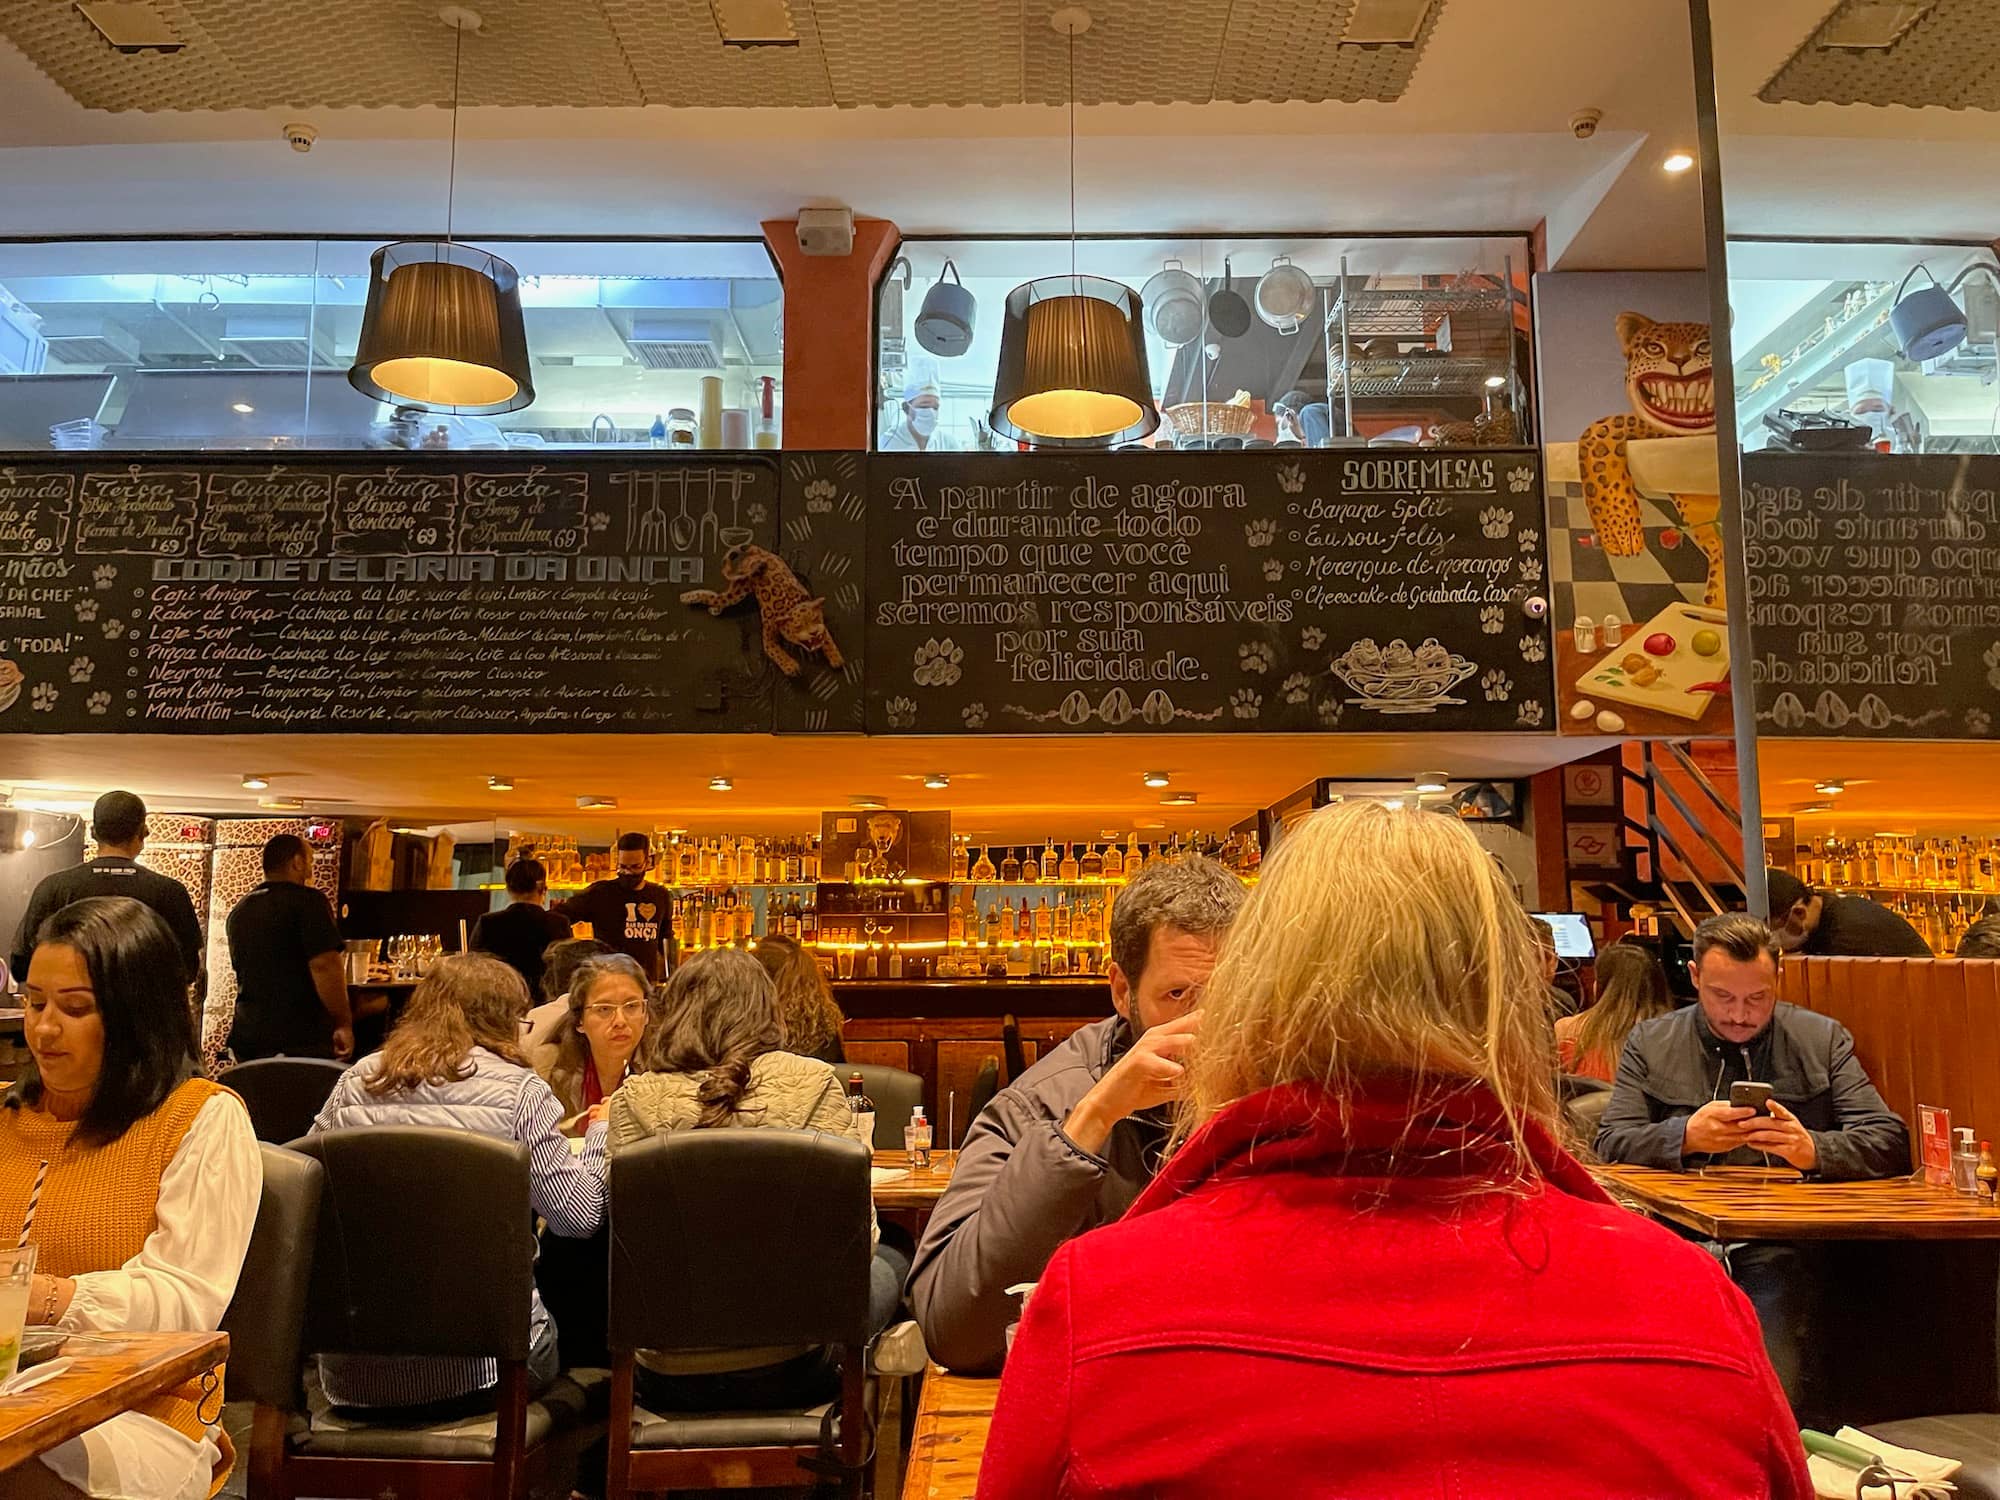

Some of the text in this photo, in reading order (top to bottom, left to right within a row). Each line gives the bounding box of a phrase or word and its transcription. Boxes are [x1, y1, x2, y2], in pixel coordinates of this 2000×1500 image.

[1341, 458, 1495, 490] SOBREMESAS
[96, 480, 174, 498] Terça
[231, 479, 327, 499] Quarta
[475, 478, 560, 498] Sexta
[889, 476, 1248, 519] A partir de agora
[1303, 497, 1450, 524] Banana Split
[916, 508, 1201, 539] e durante todo
[34, 537, 52, 551] 69
[159, 538, 180, 553] 69
[416, 527, 437, 545] 69
[554, 528, 577, 548] 69
[1305, 524, 1340, 547] Eu
[1340, 529, 1386, 547] sou
[891, 538, 1192, 575] tempo que você
[5, 556, 76, 586] mãos
[152, 556, 704, 585] COQUETELARIA DA ONÇA
[1305, 551, 1513, 586] Merengue de morango
[7, 587, 28, 602] DA
[201, 584, 260, 605] Amigo
[362, 586, 382, 601] da
[902, 563, 1231, 603] permanecer aqui
[1390, 584, 1409, 603] de
[1410, 581, 1481, 610] Goiabada
[149, 604, 201, 622] Rabo
[203, 602, 225, 620] de
[231, 604, 282, 625] Onça
[353, 605, 373, 620] da
[876, 593, 1294, 631] seremos responsáveis
[149, 624, 191, 644] Laje
[193, 625, 243, 640] Sour
[339, 624, 361, 641] da
[995, 628, 1145, 662] por sua
[147, 643, 198, 665] Pinga
[201, 642, 267, 660] Colada
[333, 644, 361, 661] da
[149, 661, 227, 684] Negroni
[144, 683, 185, 699] Tom
[187, 680, 244, 700] Collins
[145, 700, 231, 720] Manhattan
[252, 703, 328, 724] Woodford
[624, 927, 658, 942] ONÇA
